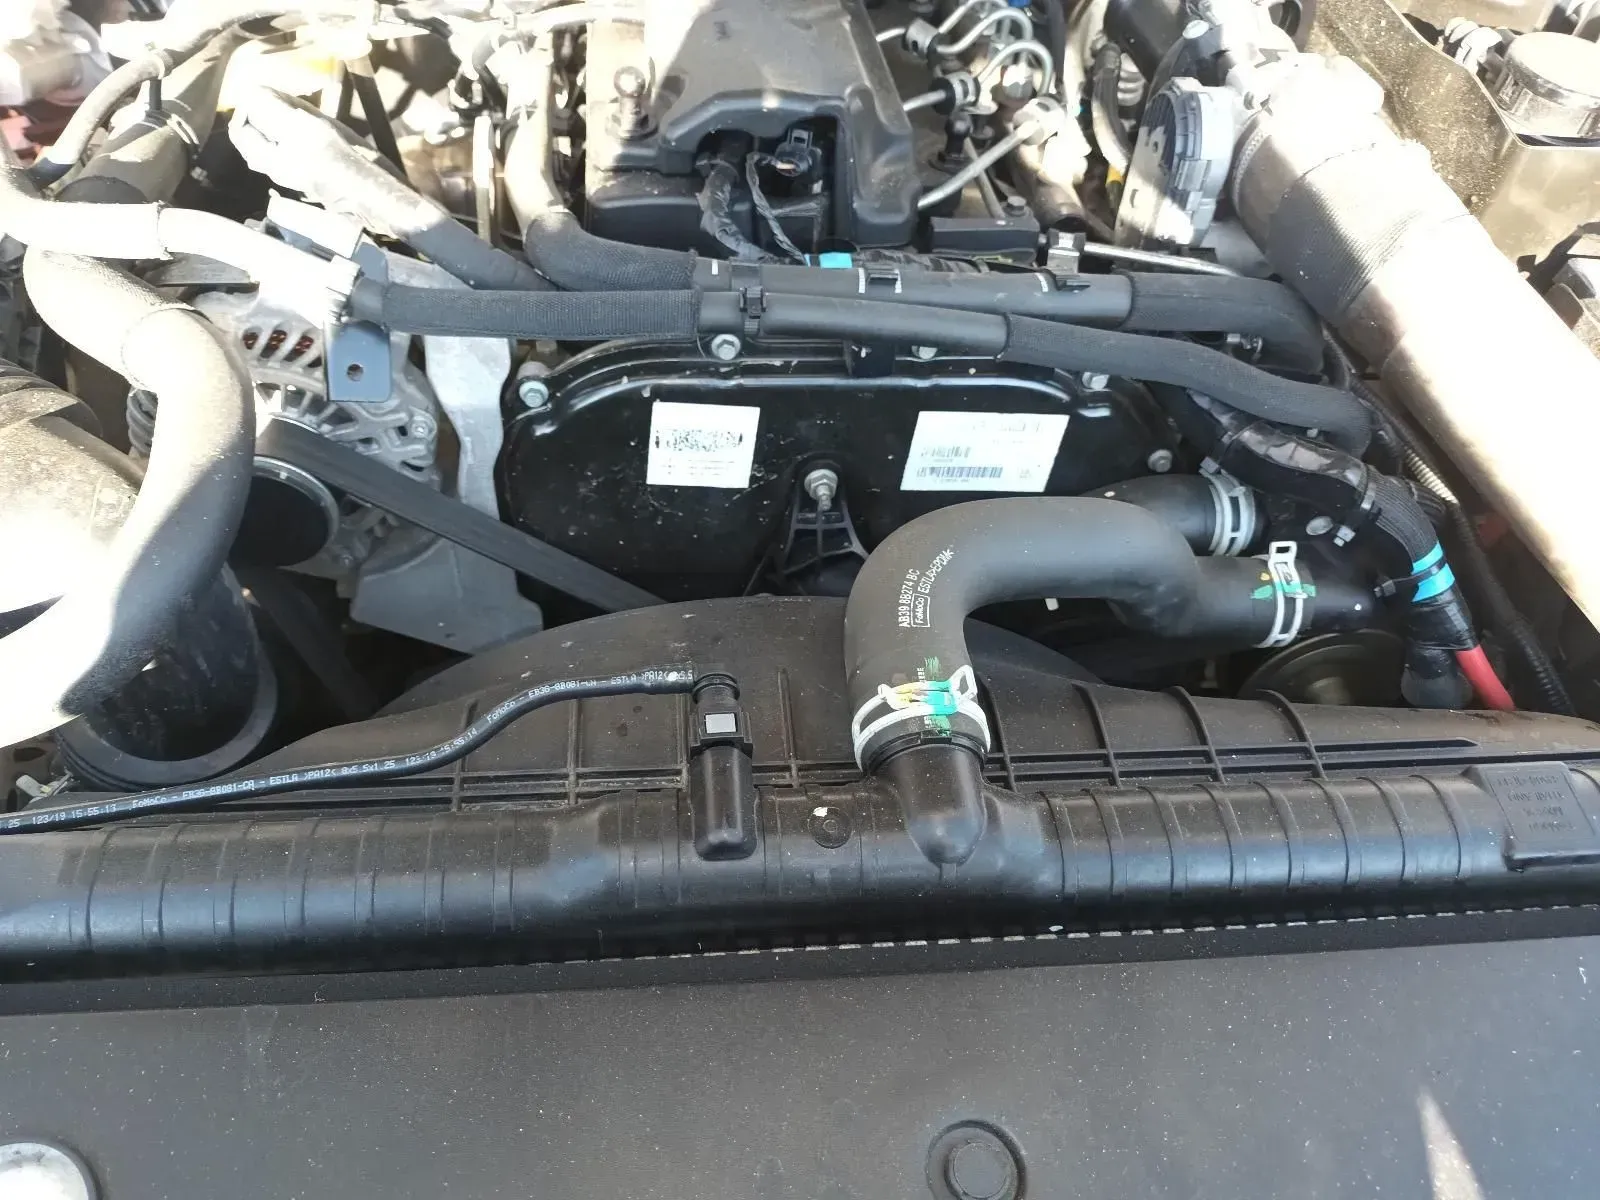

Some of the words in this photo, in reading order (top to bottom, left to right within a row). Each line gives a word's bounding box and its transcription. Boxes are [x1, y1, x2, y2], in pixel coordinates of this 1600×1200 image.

[906, 568, 920, 581] BC
[899, 581, 915, 604] 8B274
[898, 605, 911, 628] AB39
[914, 597, 925, 624] FoMoCo
[32, 811, 66, 825] 123/19
[71, 803, 118, 819] 15:55:13
[132, 796, 168, 809] FoMoCo
[486, 701, 516, 724] FoMoCo
